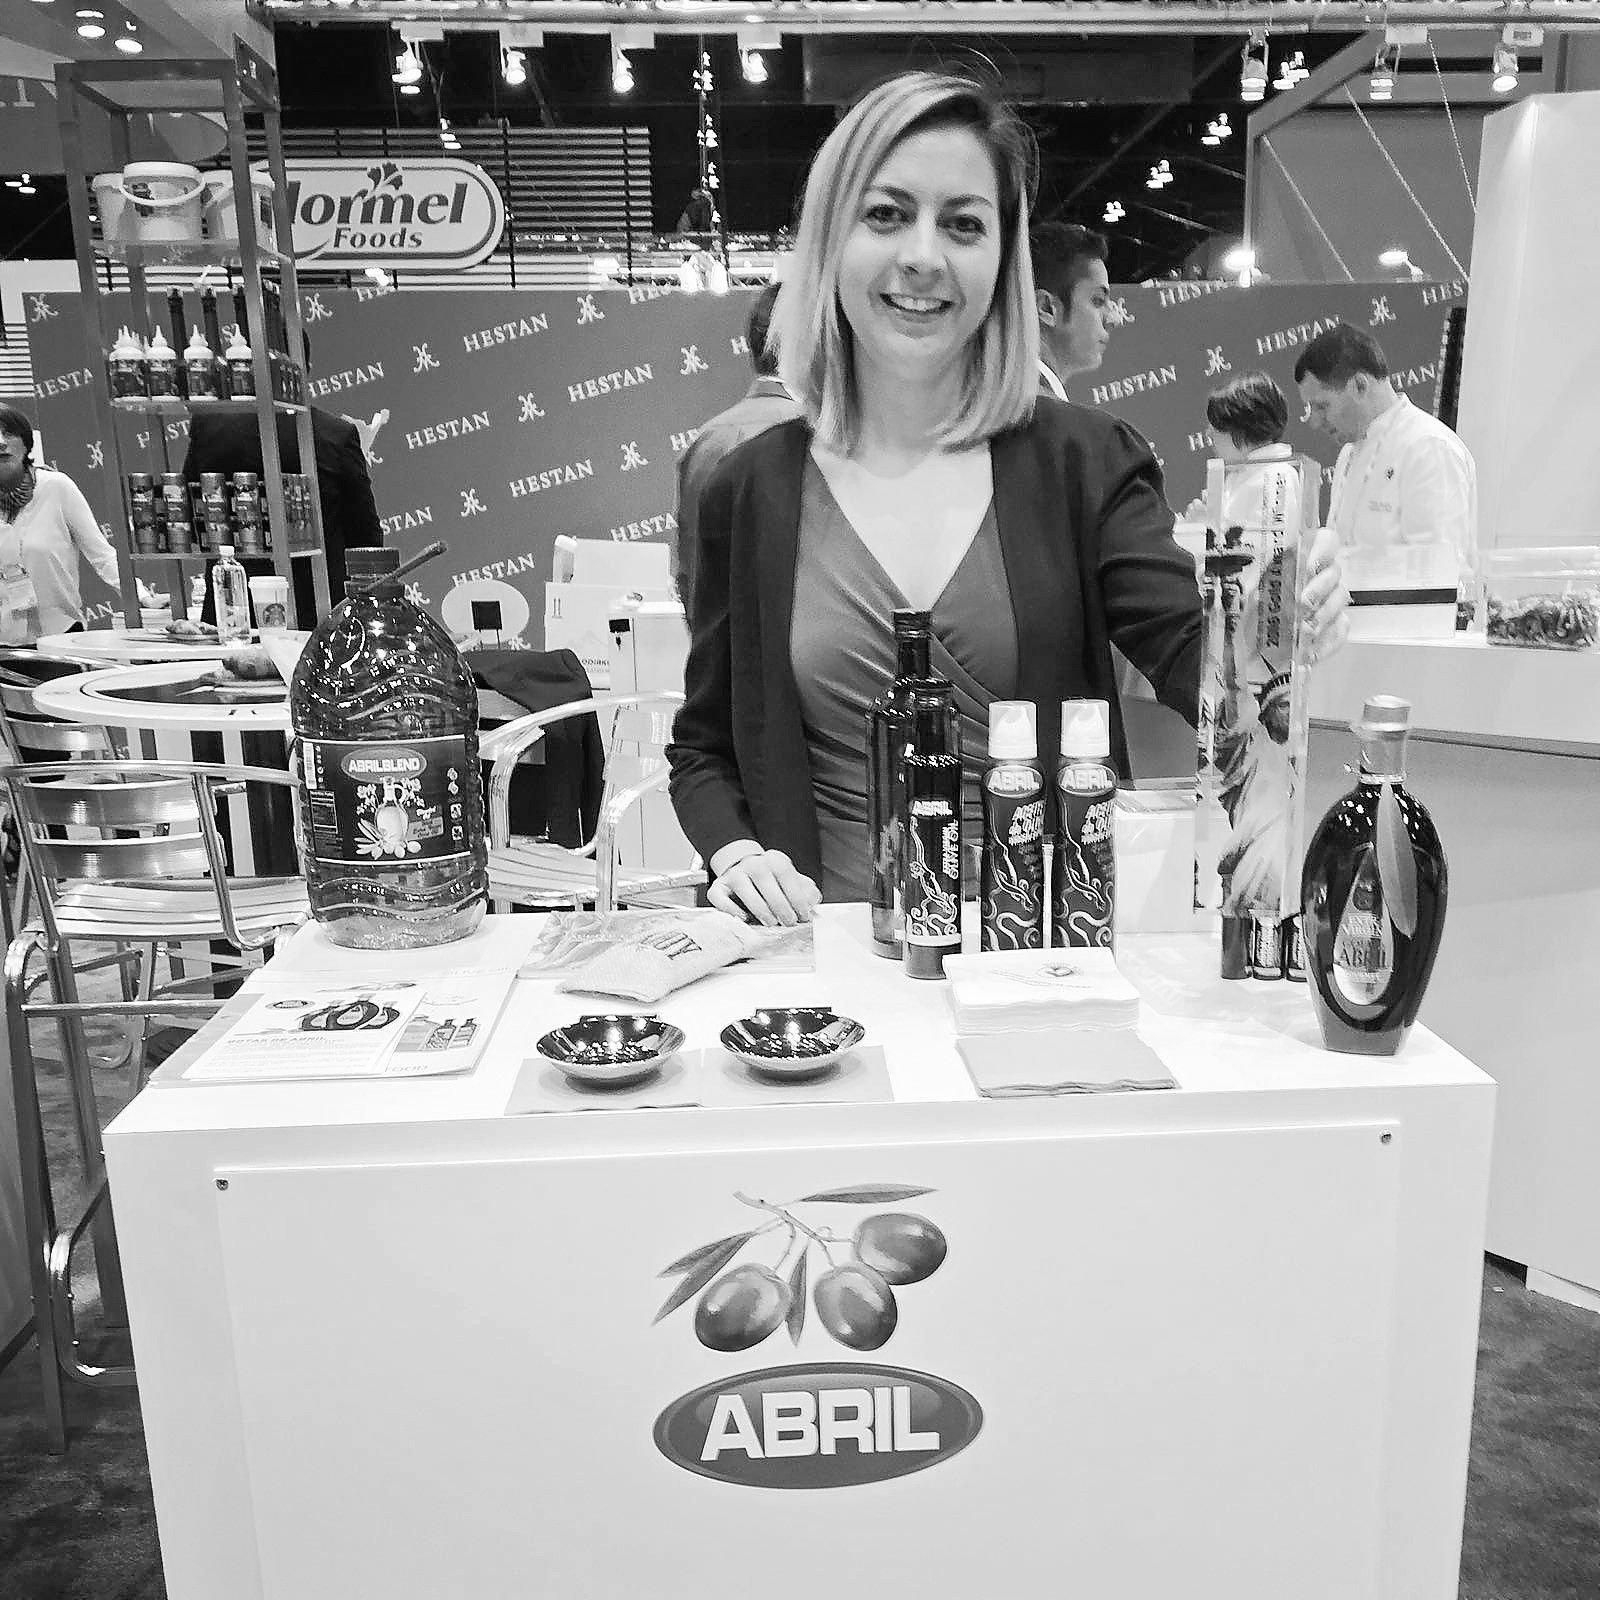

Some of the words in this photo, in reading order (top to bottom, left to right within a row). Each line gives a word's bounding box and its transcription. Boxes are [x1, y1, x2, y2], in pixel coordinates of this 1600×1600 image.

[333, 227, 424, 248] Foods
[463, 313, 549, 352] HESTAN
[567, 363, 654, 402] HESTAN
[1092, 365, 1177, 405] HESTAN
[1391, 362, 1436, 388] TAN
[405, 411, 490, 450] HESTAN
[509, 458, 594, 498] HESTAN
[379, 507, 434, 536] STAN
[611, 512, 679, 542] HESTA
[452, 553, 535, 587] HESTAN
[700, 1385, 940, 1462] ABRIL
